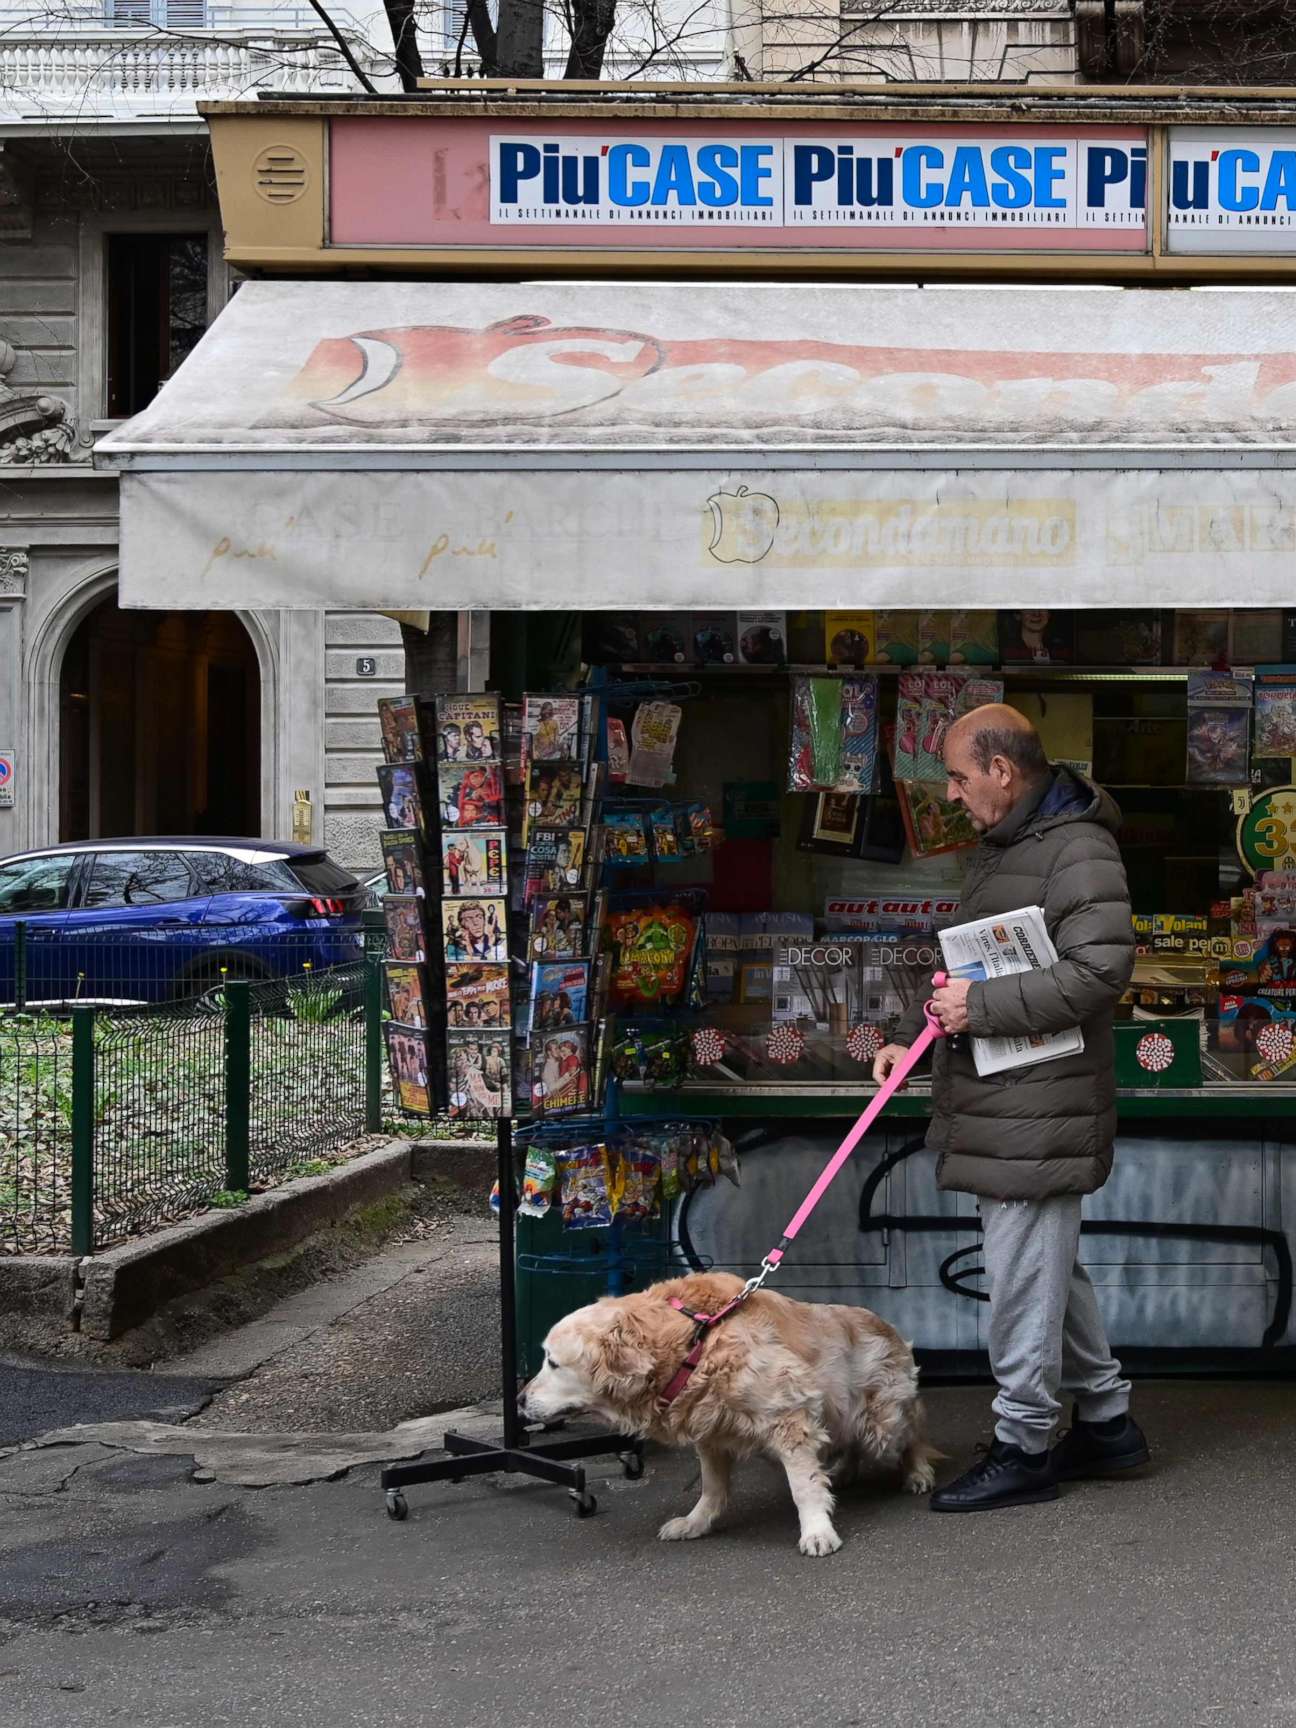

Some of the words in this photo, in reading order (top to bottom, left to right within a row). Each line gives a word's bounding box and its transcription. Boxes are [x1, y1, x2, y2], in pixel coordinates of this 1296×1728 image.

[499, 208, 509, 219] IL
[518, 208, 601, 219] SETTIMANALE
[609, 209, 621, 220] DI
[630, 210, 682, 220] ANNUNCI
[692, 210, 773, 221] IMMOBILIARI
[793, 210, 804, 220] IL
[812, 210, 894, 221] SETTIMANALE
[903, 211, 914, 221] DI
[923, 211, 976, 221] ANNUNCI
[985, 212, 1067, 223] IMMOBILIARI
[1086, 212, 1096, 222] IL
[1218, 215, 1230, 225] DI
[1239, 215, 1291, 226] ANNUNCI
[361, 660, 371, 673] 5
[438, 711, 497, 722] CAPITANI
[535, 832, 556, 841] FBI
[530, 846, 557, 855] COSA
[1154, 935, 1184, 948] sale
[788, 947, 852, 966] DECOR
[880, 947, 943, 966] DECOR
